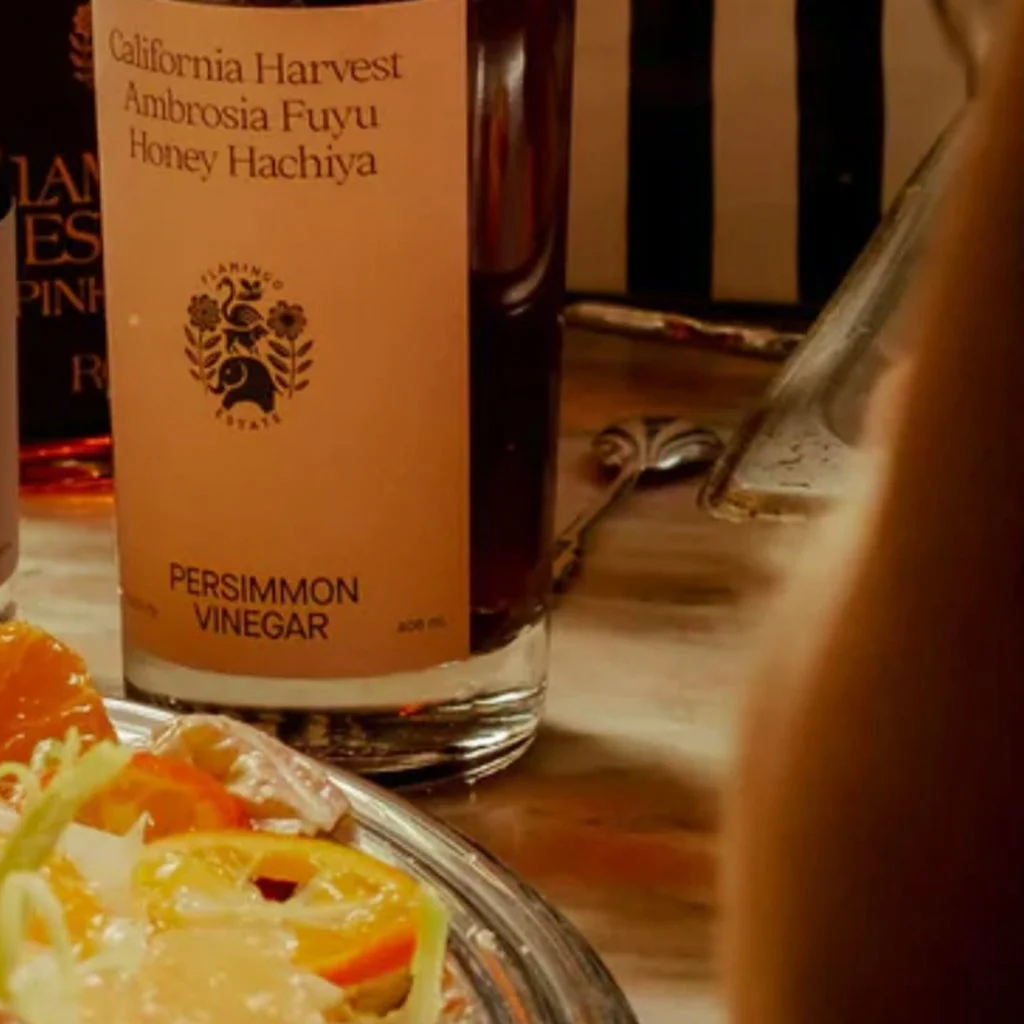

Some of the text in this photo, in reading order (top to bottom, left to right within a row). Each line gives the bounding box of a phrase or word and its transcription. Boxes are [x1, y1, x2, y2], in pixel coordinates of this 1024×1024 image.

[108, 28, 404, 86] California Harvest
[123, 81, 382, 140] Ambrosia Fuyu
[129, 127, 378, 185] Honey Hachiya
[200, 261, 285, 291] FLAMINGO
[169, 561, 360, 605] PERSIMMON
[193, 602, 330, 641] VINEGAR
